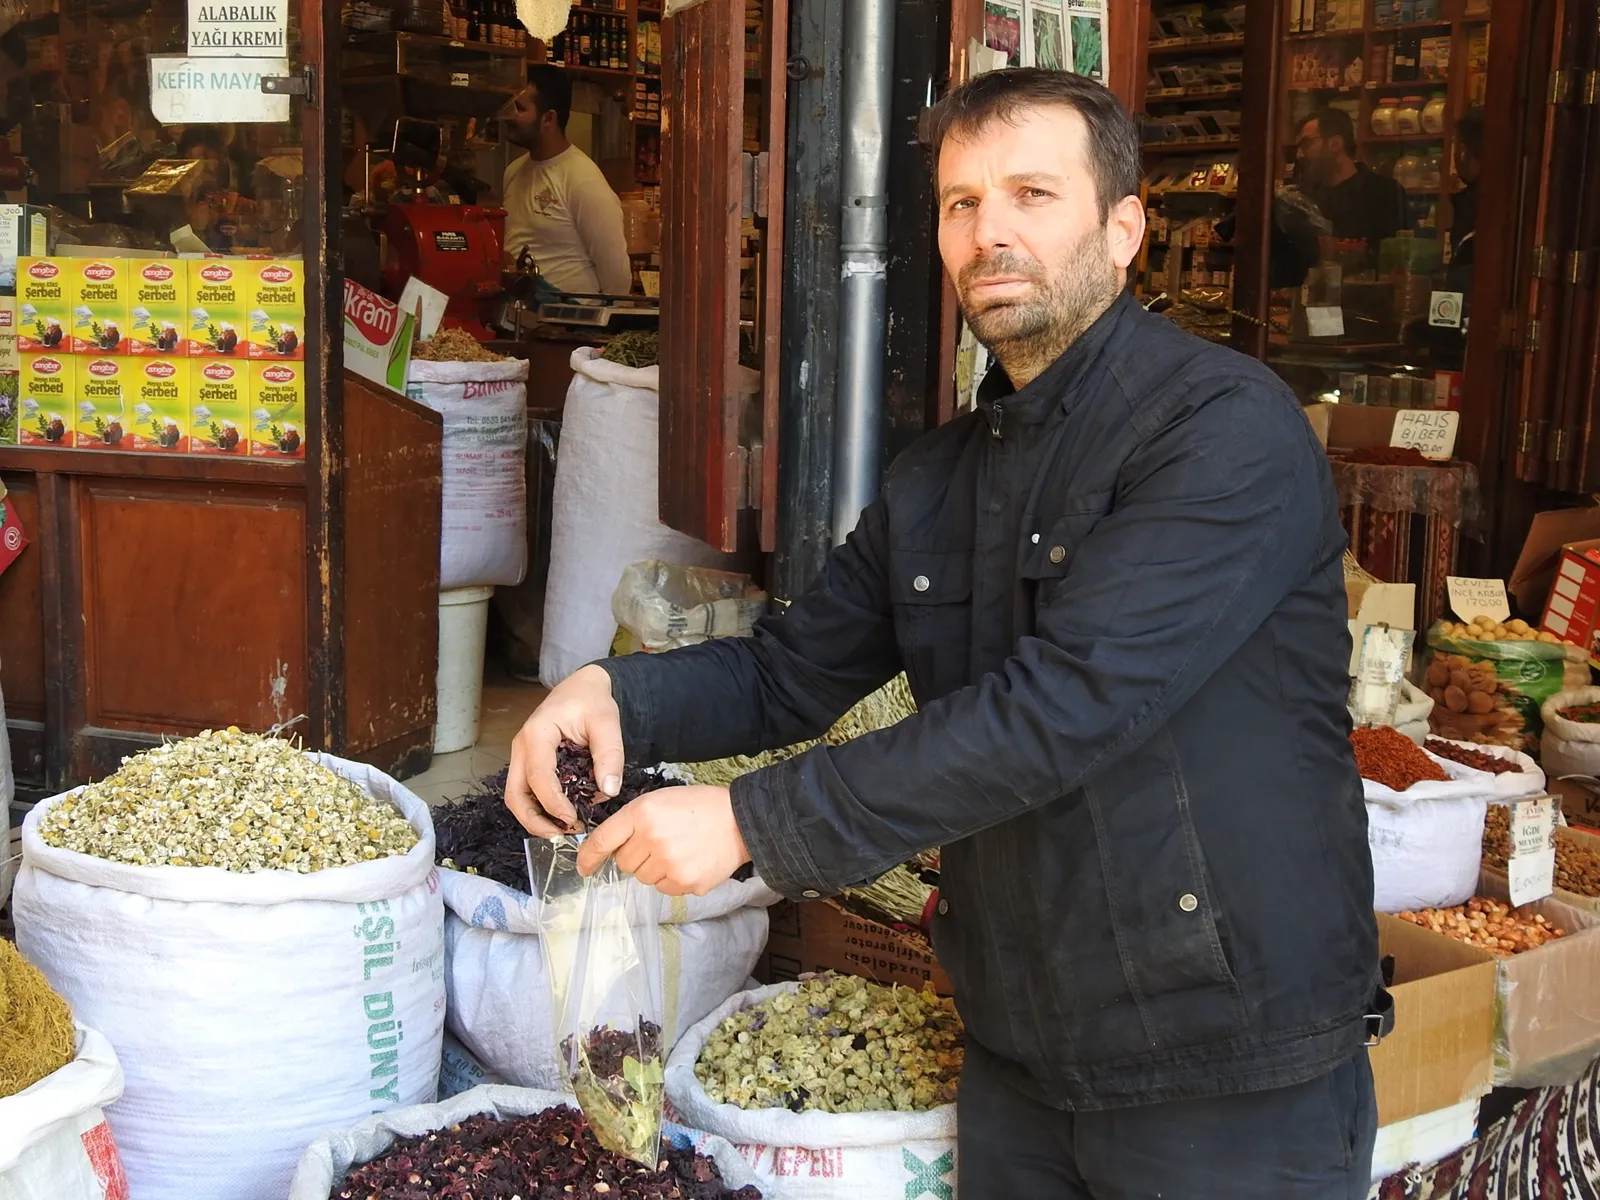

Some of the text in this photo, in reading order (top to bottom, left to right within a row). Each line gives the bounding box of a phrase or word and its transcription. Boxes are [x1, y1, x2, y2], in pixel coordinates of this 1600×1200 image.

[198, 6, 276, 21] ALABALIK
[192, 28, 283, 46] YAĞI KREMİ
[157, 68, 281, 90] KEFİR MAYA
[344, 282, 392, 333] ikram
[353, 899, 404, 1115] EŞİL DÜNY
